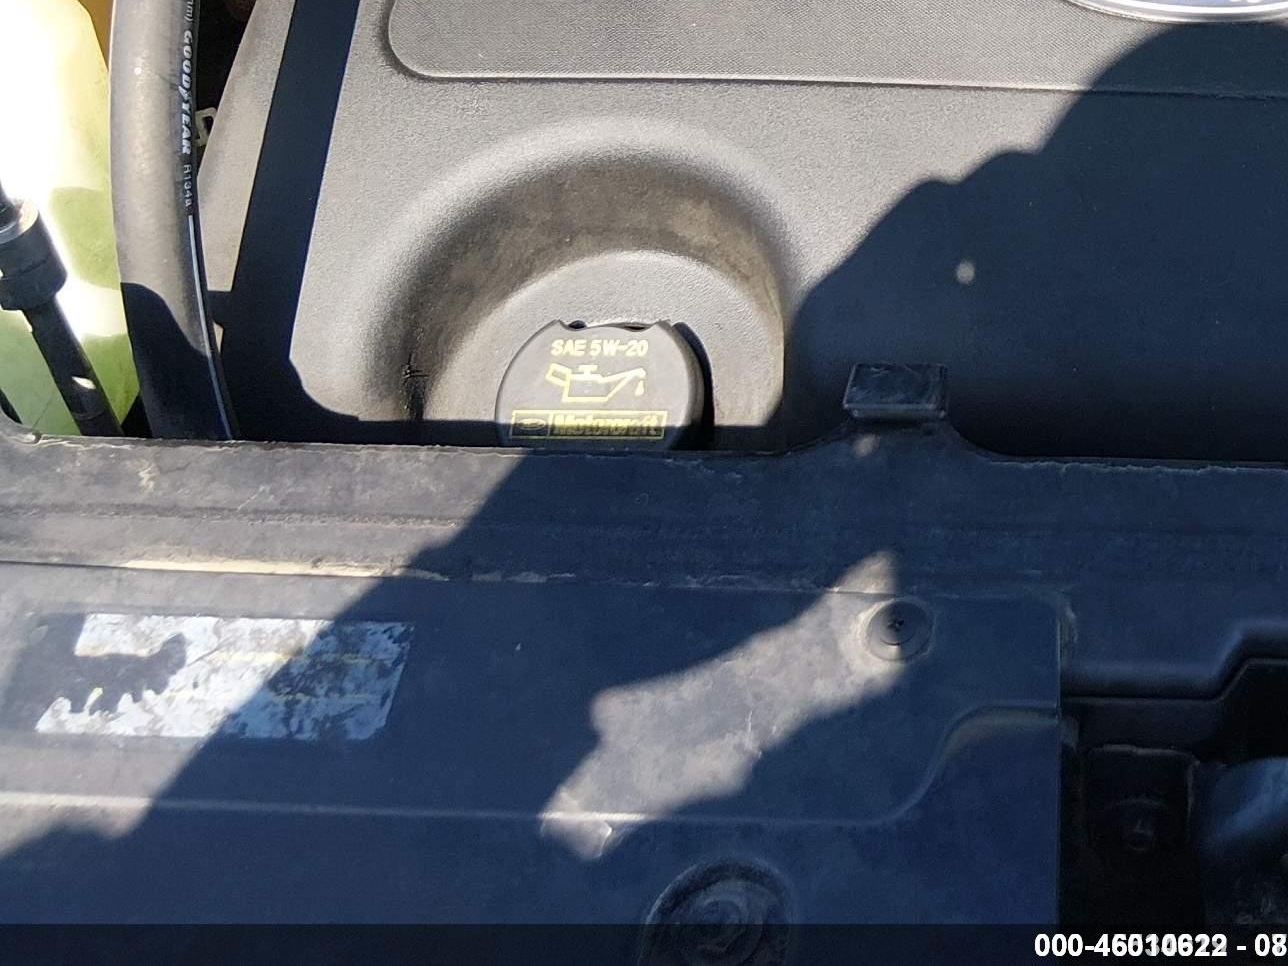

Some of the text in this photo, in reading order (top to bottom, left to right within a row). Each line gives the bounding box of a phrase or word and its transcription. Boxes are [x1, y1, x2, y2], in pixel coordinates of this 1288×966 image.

[179, 29, 194, 155] GOODYEAR
[551, 339, 649, 357] SAE 5W-20
